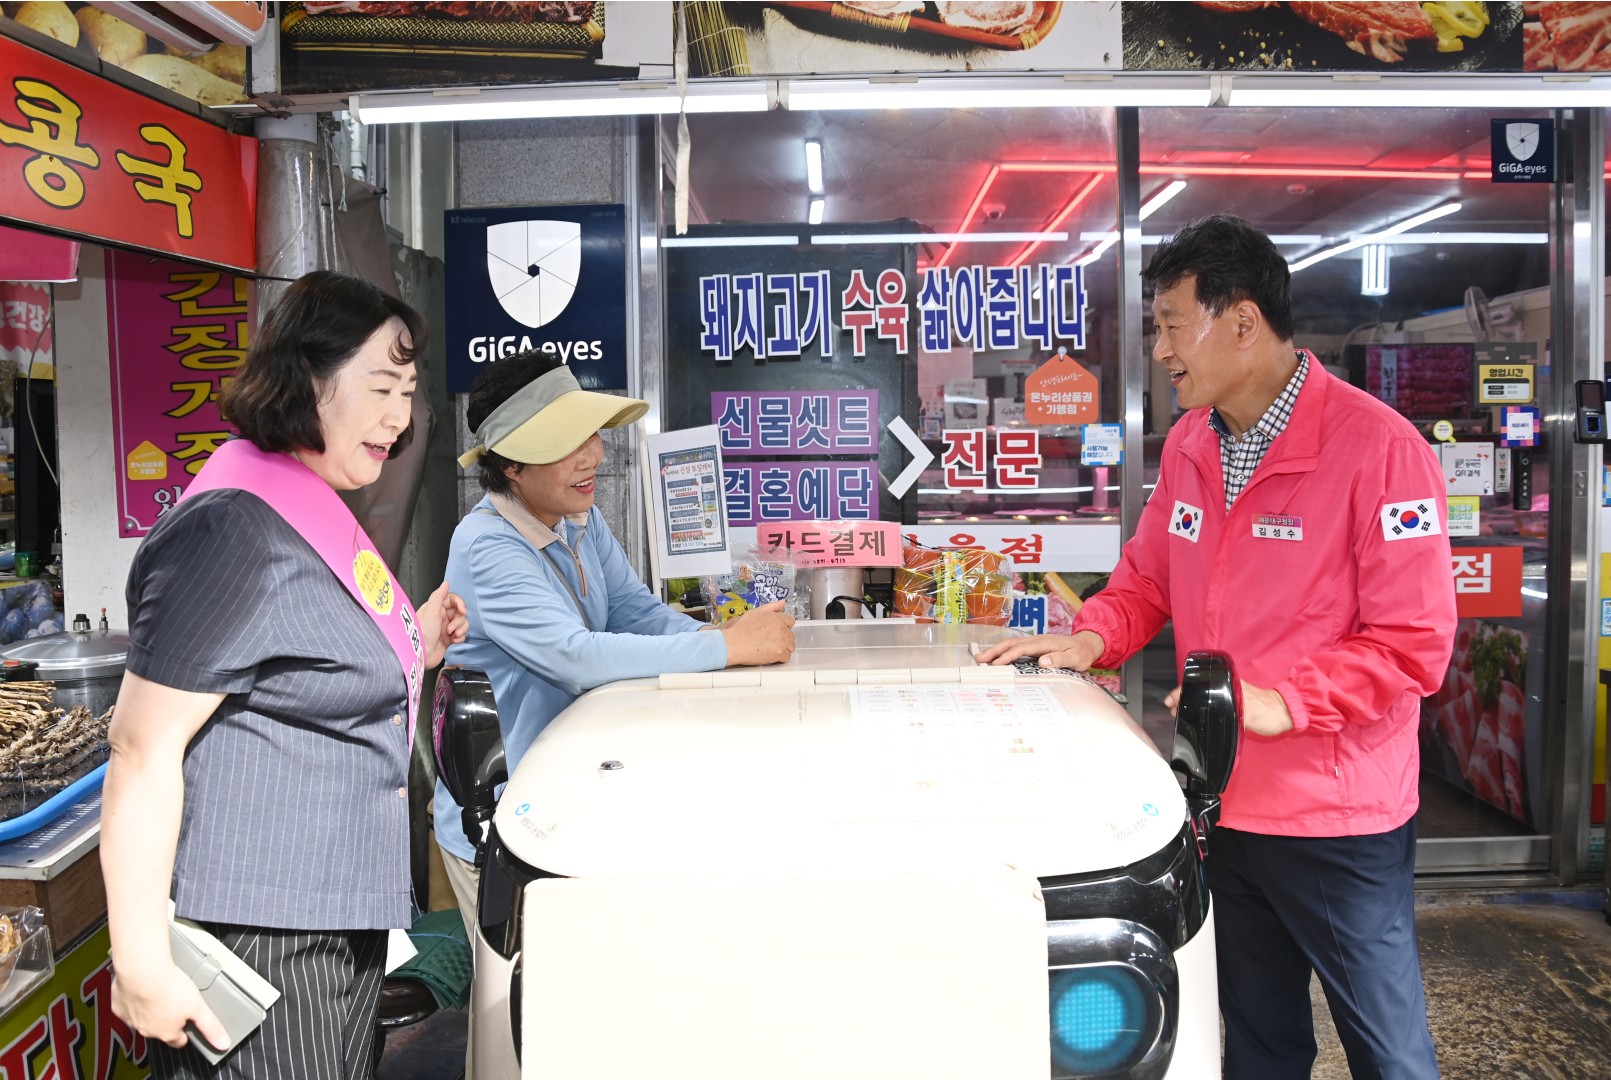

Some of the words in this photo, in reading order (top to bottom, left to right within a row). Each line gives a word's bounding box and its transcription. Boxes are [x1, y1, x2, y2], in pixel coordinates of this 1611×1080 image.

[1499, 162, 1523, 174] GiGA
[1524, 165, 1547, 175] eyes
[699, 270, 833, 361] 돼지고기
[841, 268, 909, 357] 수육
[918, 263, 1088, 353] 삶아줍니다
[1488, 368, 1524, 378] 영업시간
[1030, 391, 1093, 403] 온누리상품권
[1046, 403, 1078, 415] 가맹점
[717, 396, 872, 450] 선물셋트
[941, 428, 1044, 490] 전문
[722, 467, 873, 521] 결혼예단
[767, 530, 886, 557] 카드결제
